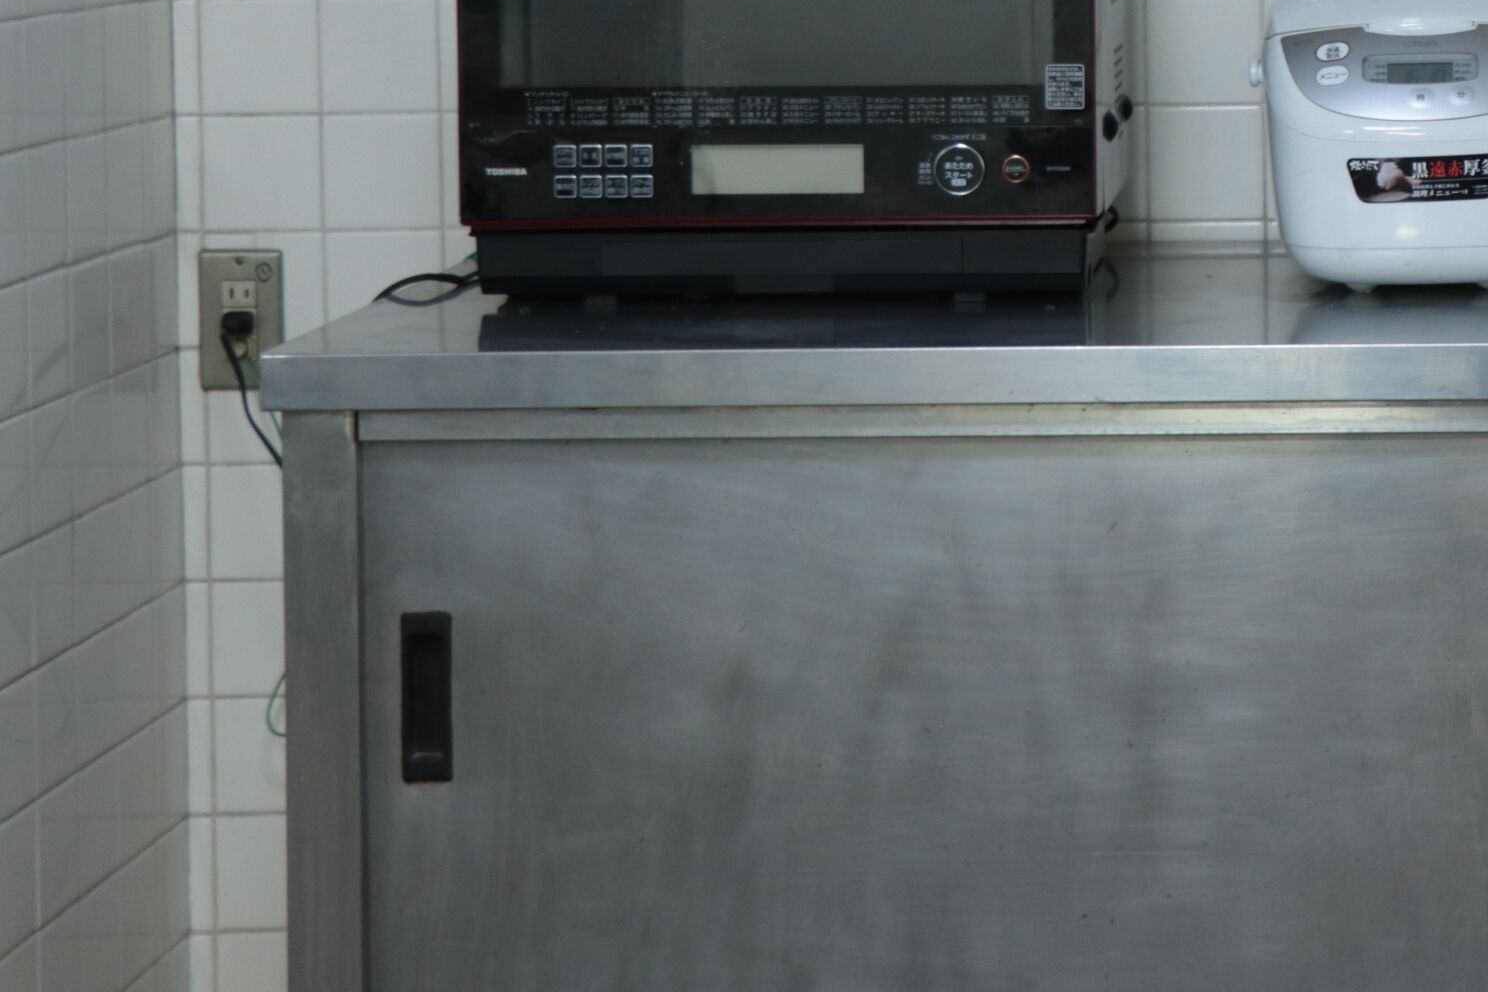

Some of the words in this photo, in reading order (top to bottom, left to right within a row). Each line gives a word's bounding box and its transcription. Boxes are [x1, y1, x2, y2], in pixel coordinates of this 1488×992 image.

[1319, 72, 1347, 81] メニュー
[944, 161, 974, 171] あたため
[485, 167, 528, 176] TOSHIBA
[944, 171, 974, 180] スタート
